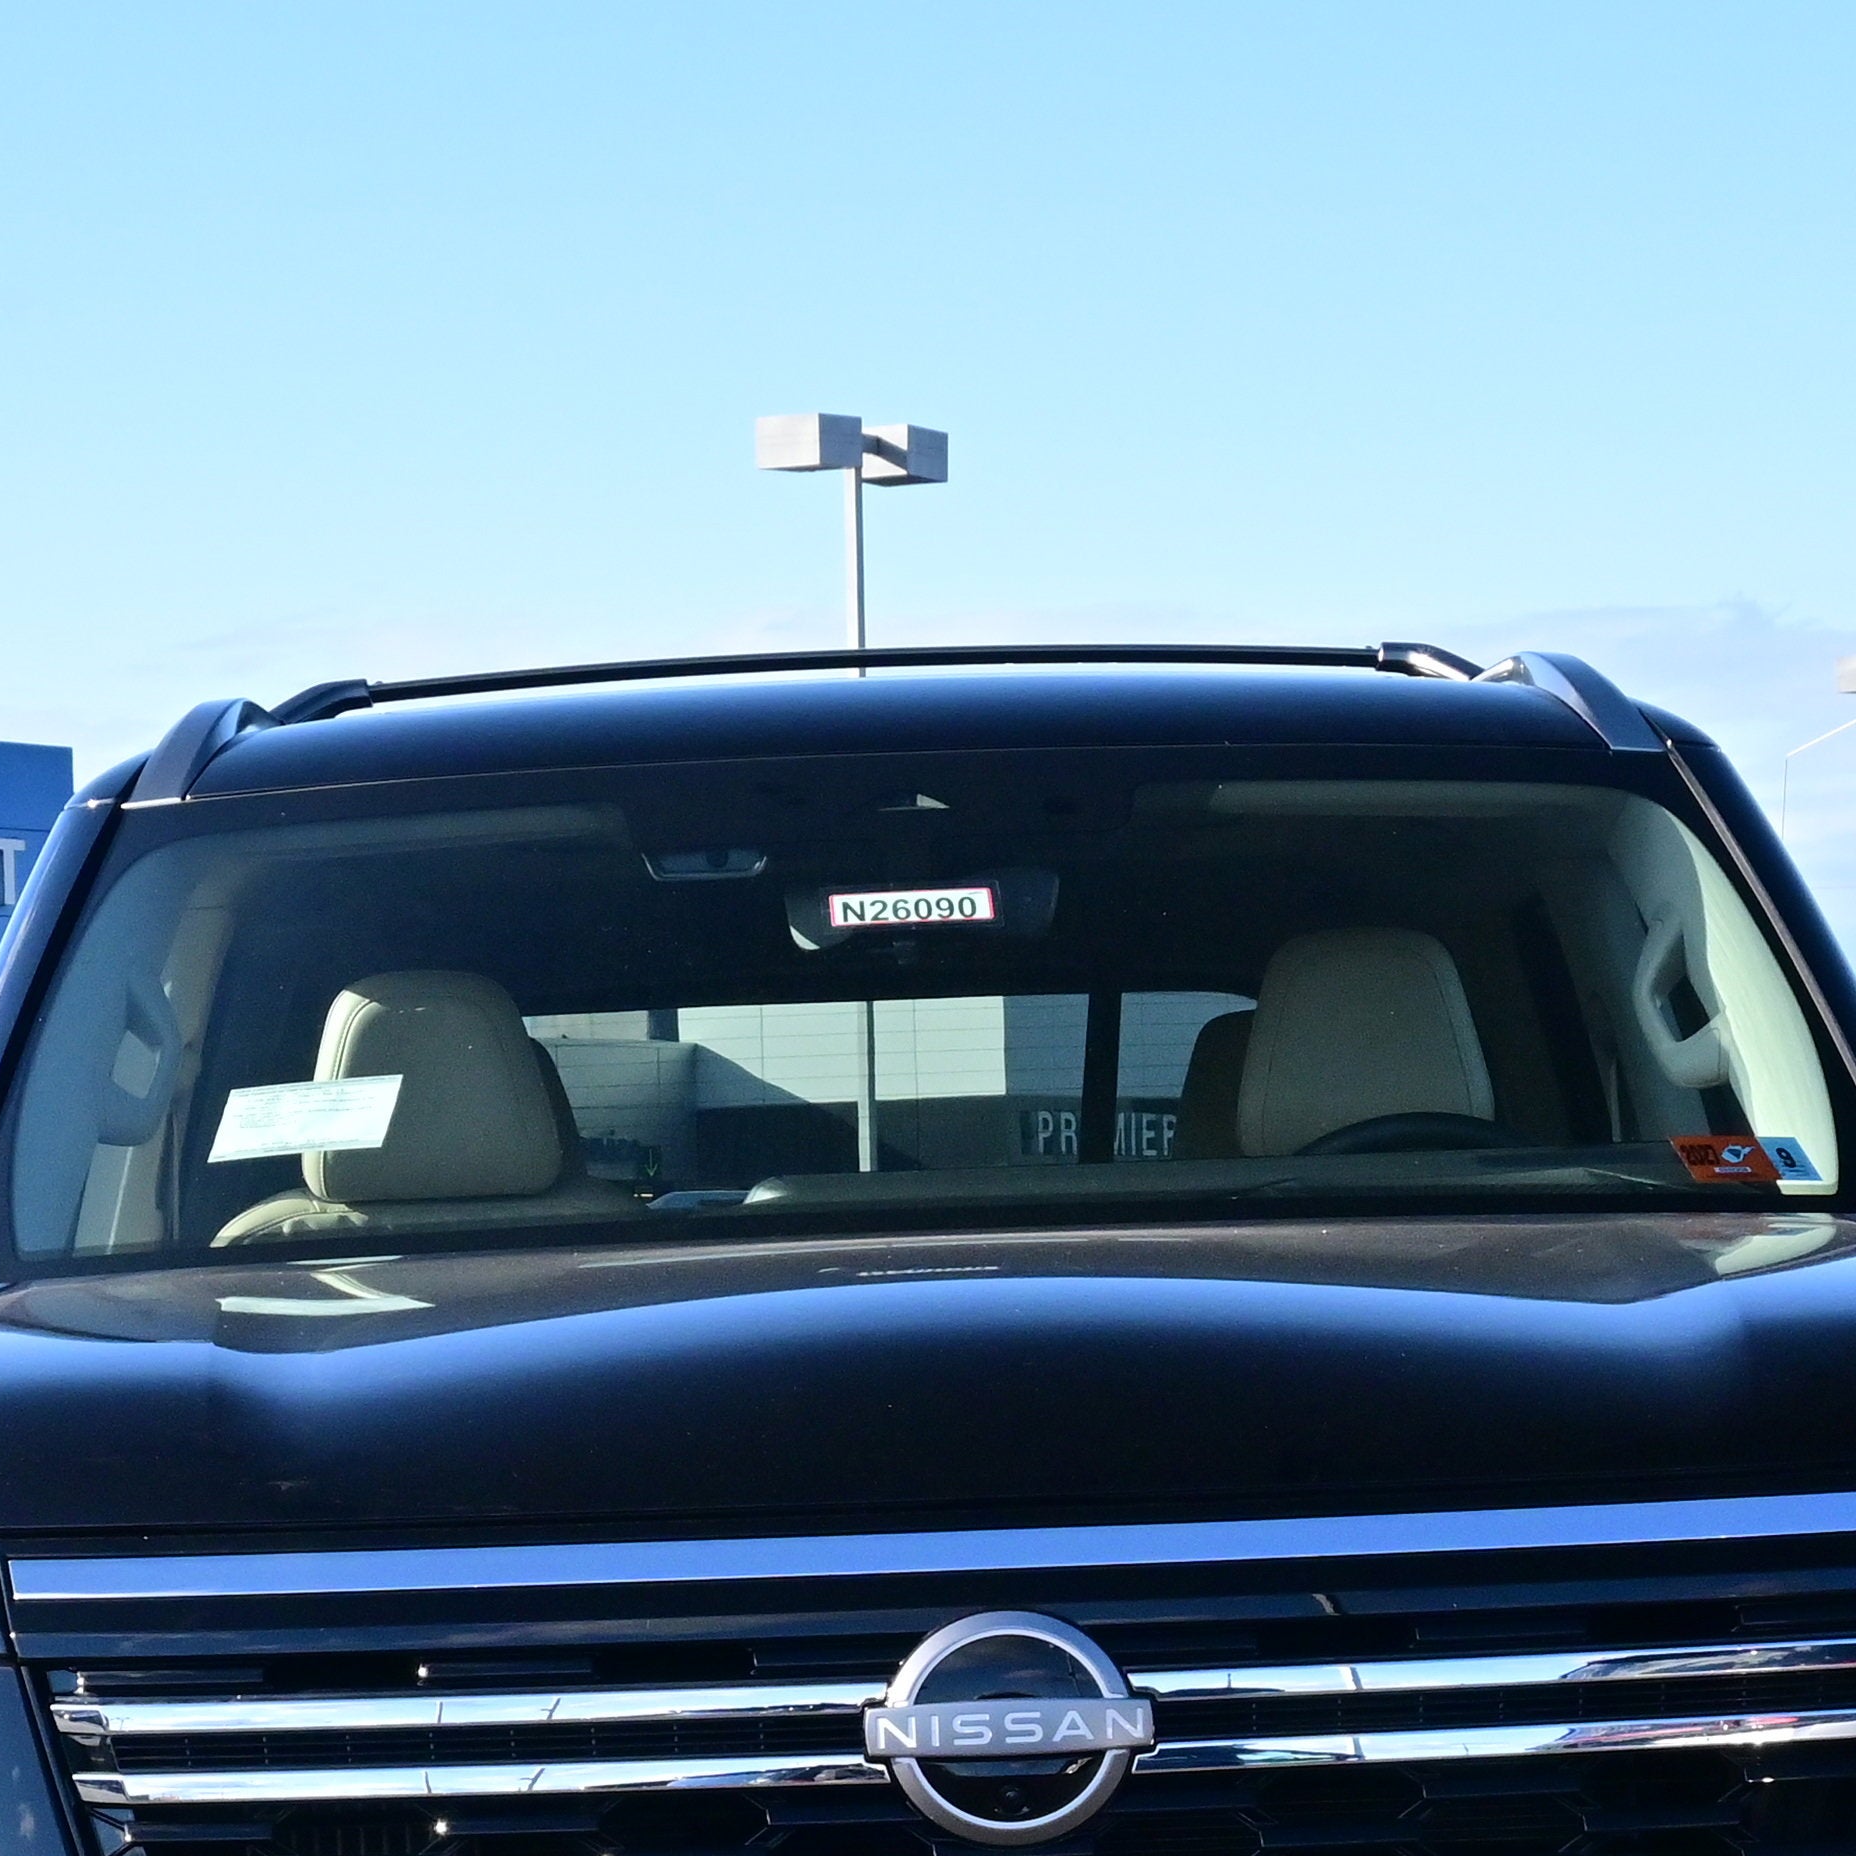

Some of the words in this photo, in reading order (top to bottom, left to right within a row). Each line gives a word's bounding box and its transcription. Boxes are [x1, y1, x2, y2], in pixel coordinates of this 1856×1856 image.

[841, 896, 977, 922] N26090
[1037, 1110, 1177, 1157] PRMIER
[1775, 1147, 1797, 1168] 9
[875, 1707, 1144, 1750] NISSAN
